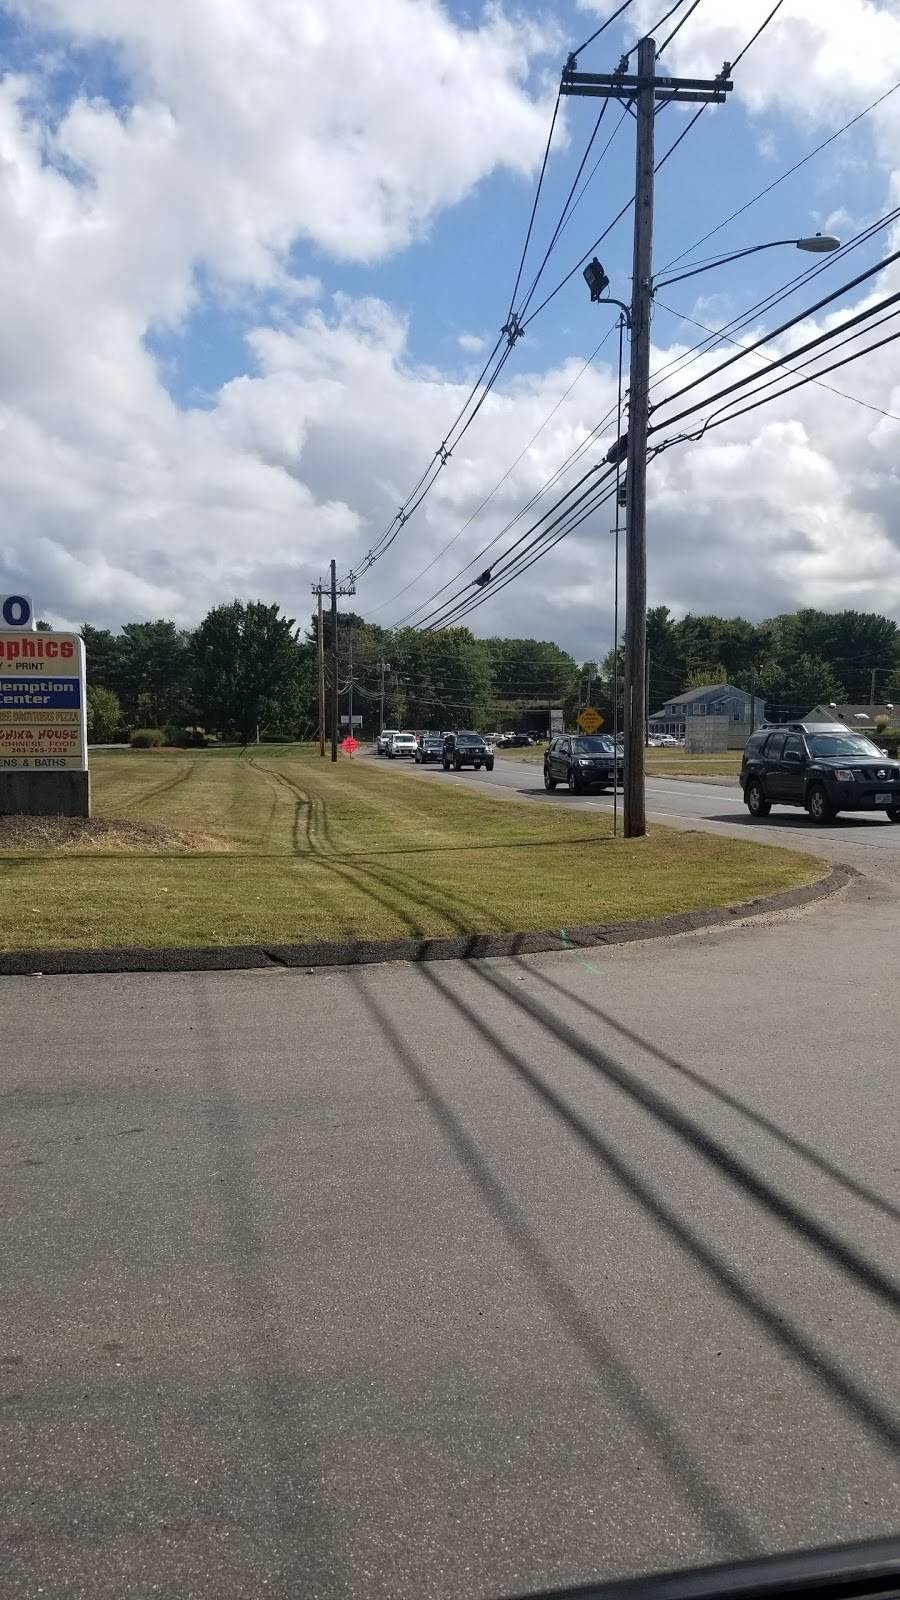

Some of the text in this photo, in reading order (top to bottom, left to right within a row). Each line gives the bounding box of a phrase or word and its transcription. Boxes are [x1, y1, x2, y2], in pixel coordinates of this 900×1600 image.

[15, 662, 45, 671] PRINT
[0, 681, 74, 694] emption
[38, 729, 79, 740] HOUSE
[22, 759, 29, 767] &
[34, 759, 66, 767] BATHS
